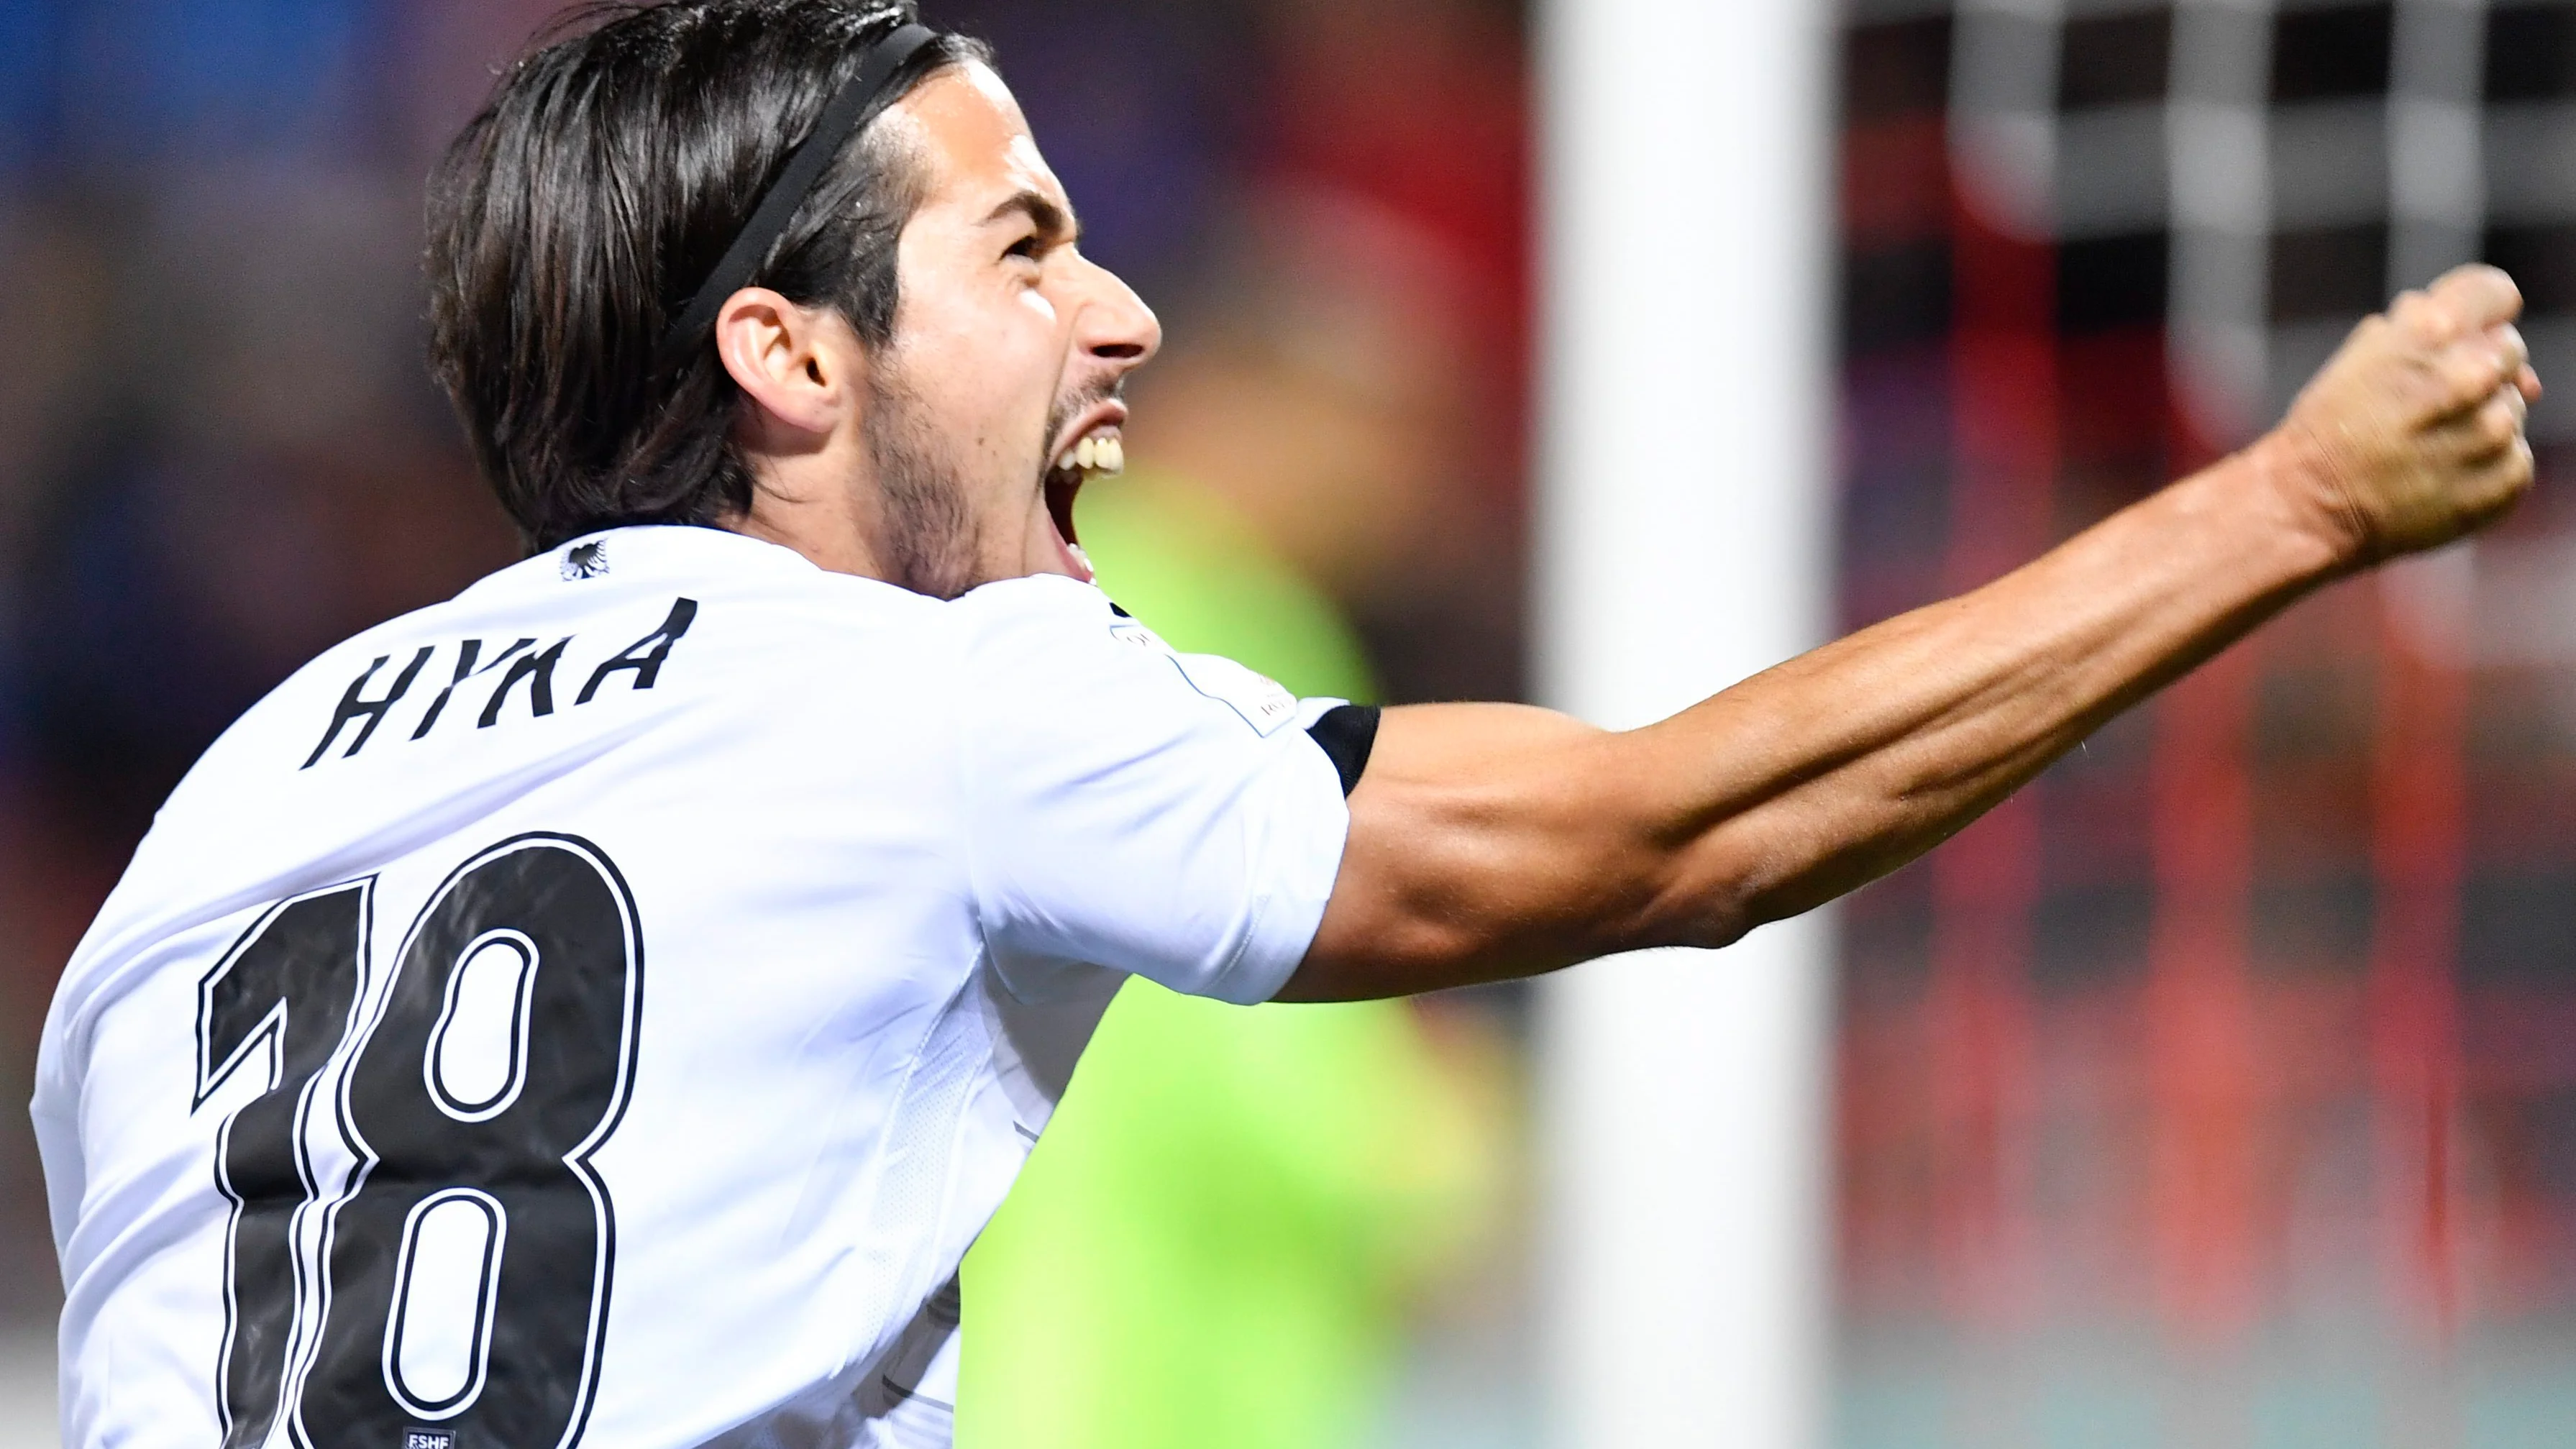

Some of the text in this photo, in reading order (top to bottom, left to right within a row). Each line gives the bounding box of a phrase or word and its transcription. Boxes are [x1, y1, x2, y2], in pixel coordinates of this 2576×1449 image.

[298, 596, 698, 770] HYKA
[190, 831, 645, 1449] 18
[408, 1434, 449, 1449] FSHF
